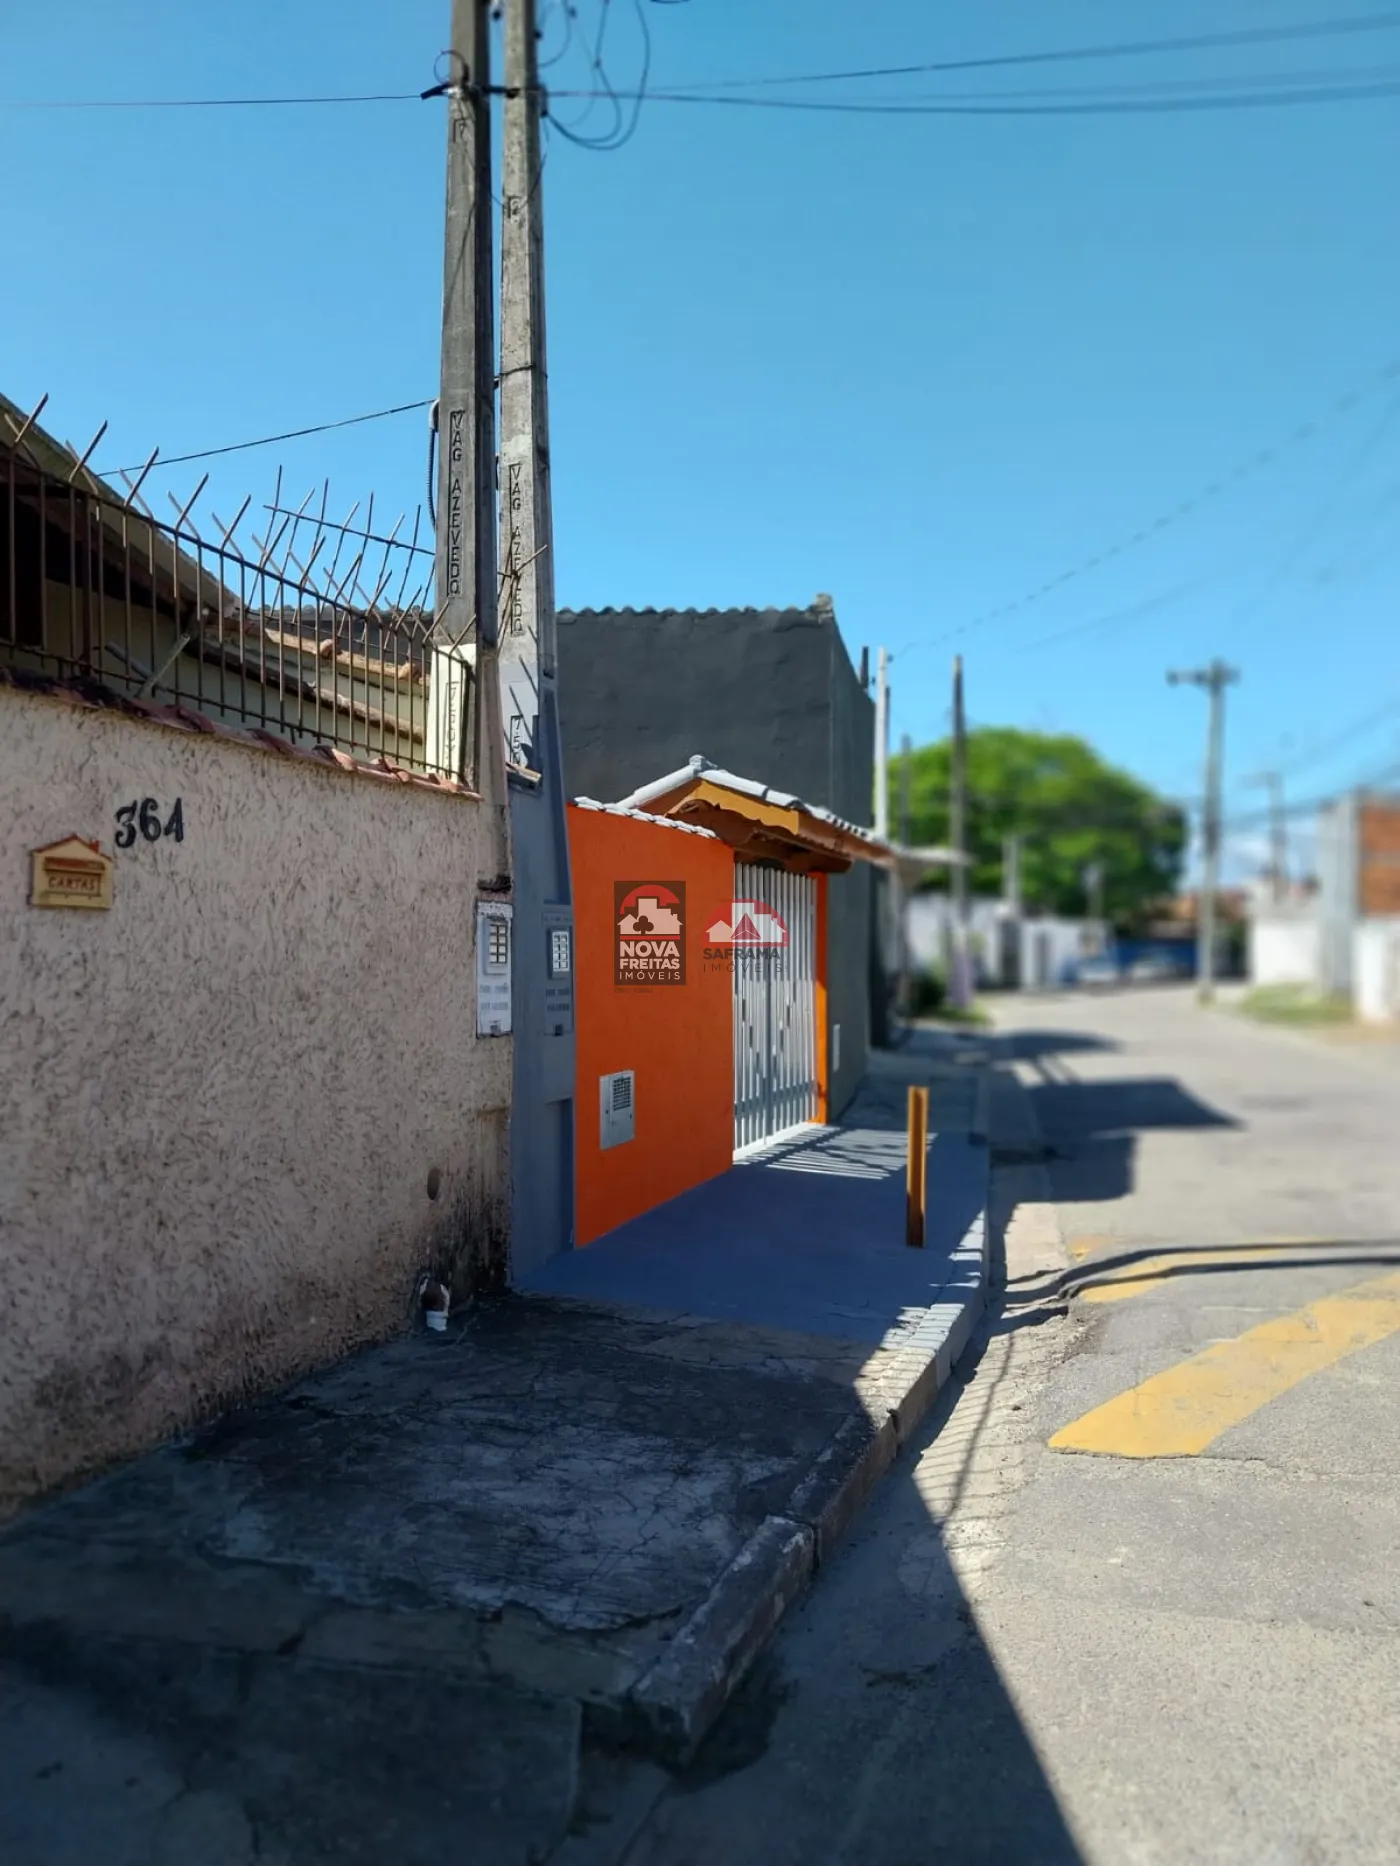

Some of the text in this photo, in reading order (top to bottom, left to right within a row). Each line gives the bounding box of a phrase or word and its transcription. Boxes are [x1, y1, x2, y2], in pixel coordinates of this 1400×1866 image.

[450, 412, 464, 594] VAG AZEVEDO
[511, 464, 522, 511] VAG
[115, 797, 184, 848] 364
[48, 875, 96, 891] CARTAS
